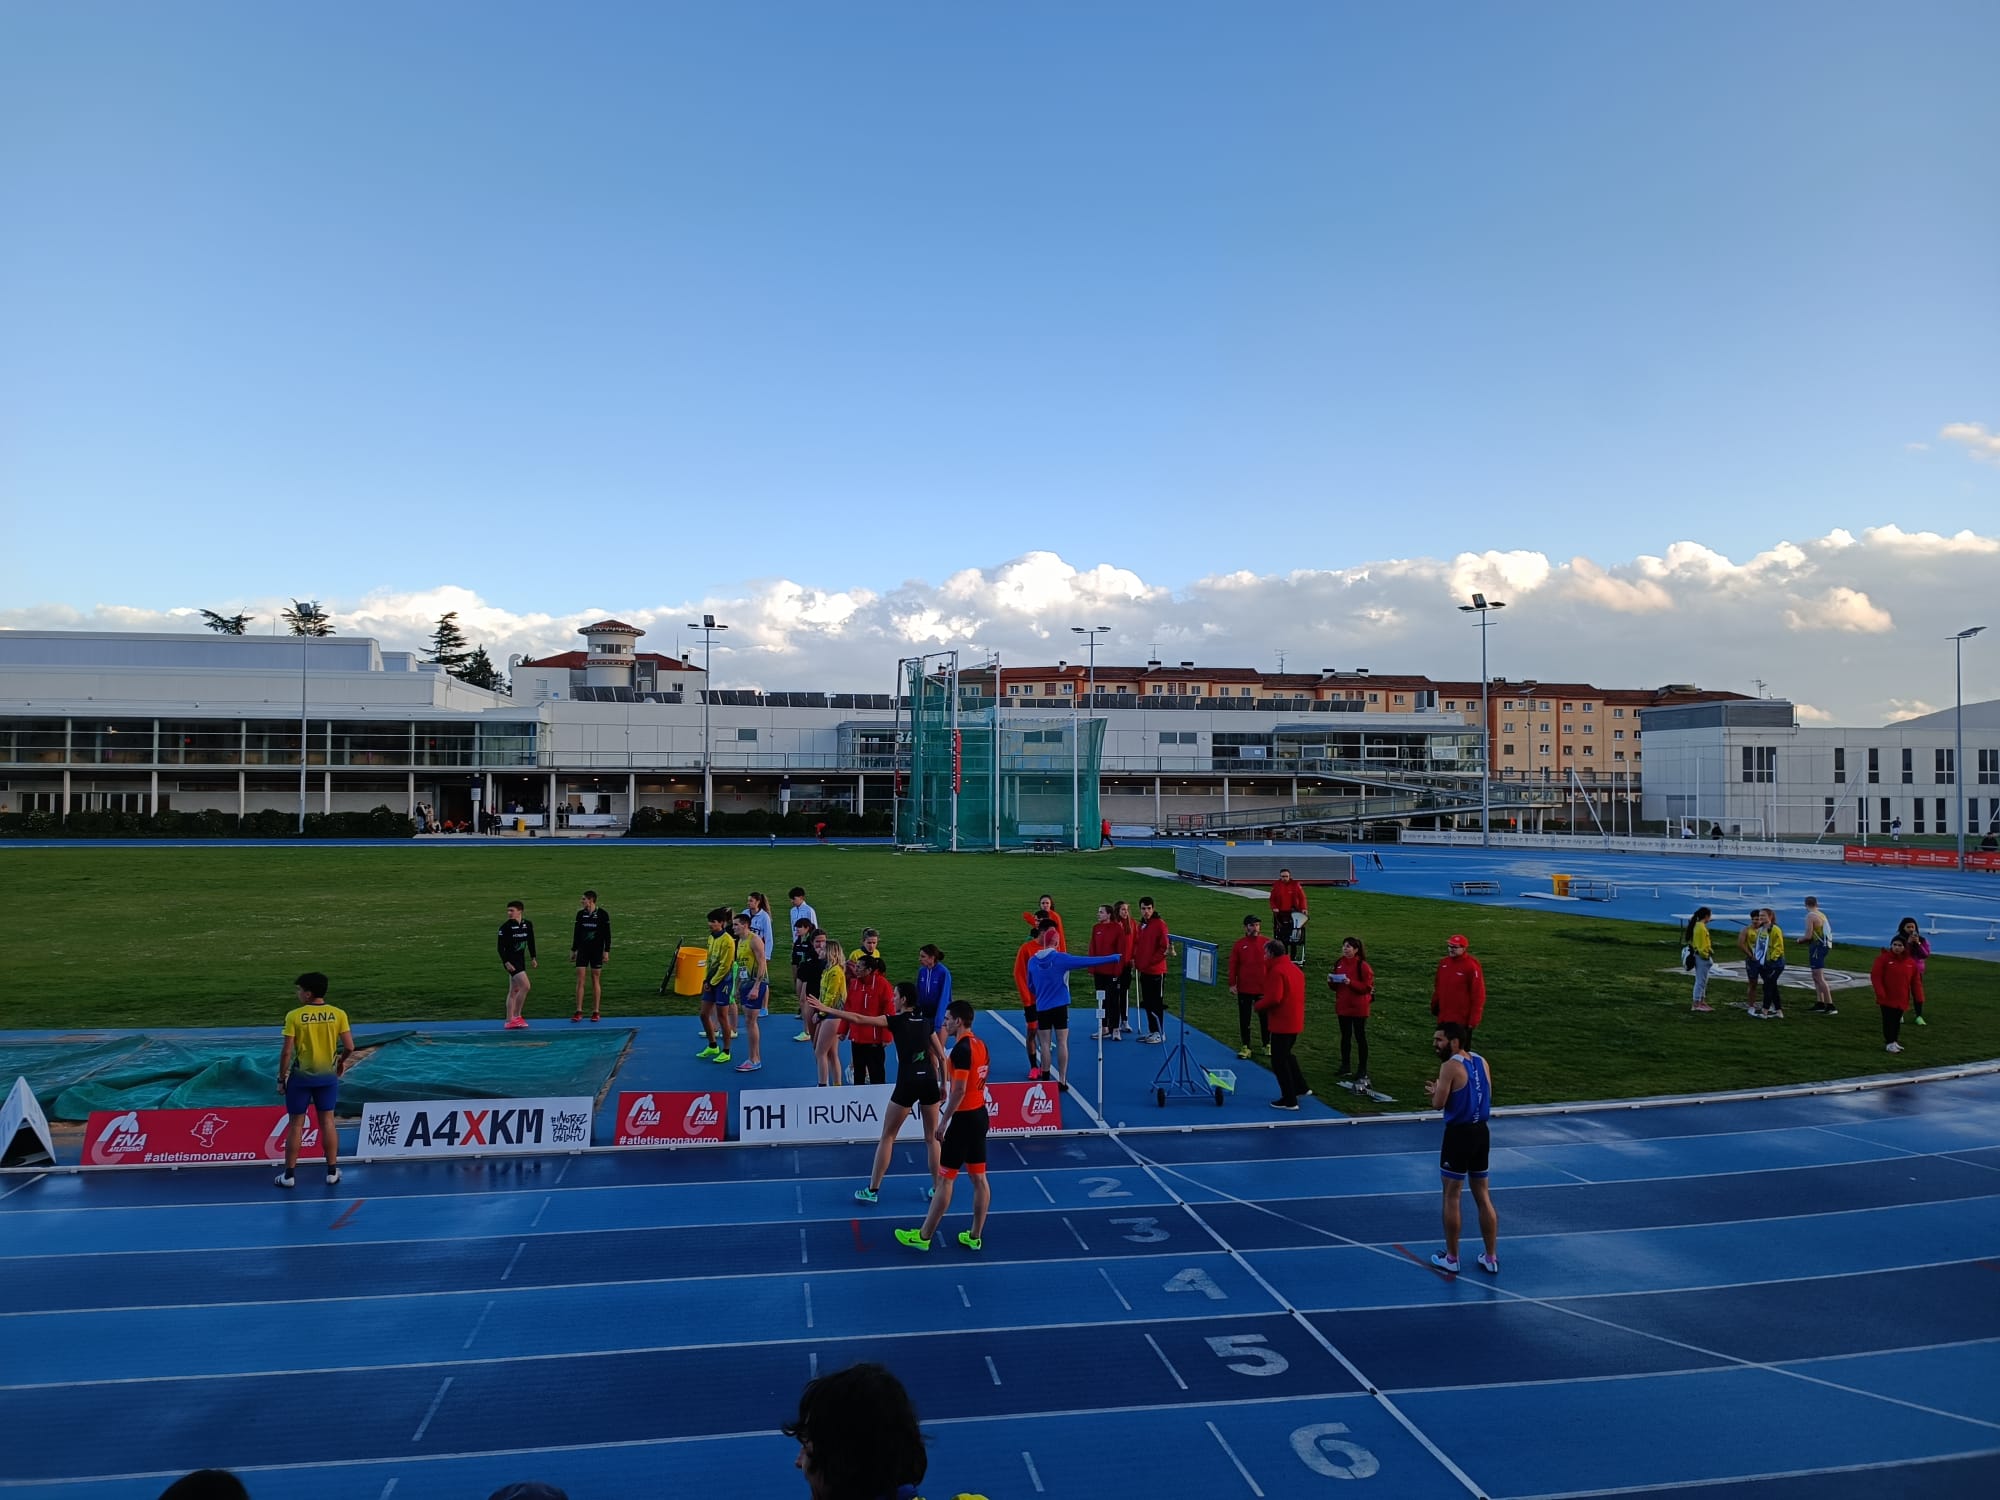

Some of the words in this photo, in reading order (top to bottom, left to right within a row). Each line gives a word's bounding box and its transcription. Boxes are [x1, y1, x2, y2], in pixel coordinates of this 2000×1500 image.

[301, 1012, 336, 1023] GANA
[637, 1110, 661, 1121] FNA
[695, 1110, 719, 1121] FNA
[808, 1100, 878, 1125] IRUÑA
[1033, 1099, 1053, 1111] FNA
[111, 1133, 148, 1146] FNA
[404, 1109, 544, 1147] A4XKM
[144, 1151, 256, 1164] #atletismonavarro
[1078, 1176, 1134, 1199] 2
[1108, 1216, 1171, 1243] 3
[1161, 1268, 1229, 1300] 4
[1204, 1333, 1290, 1377] 5
[1289, 1422, 1381, 1480] 6
